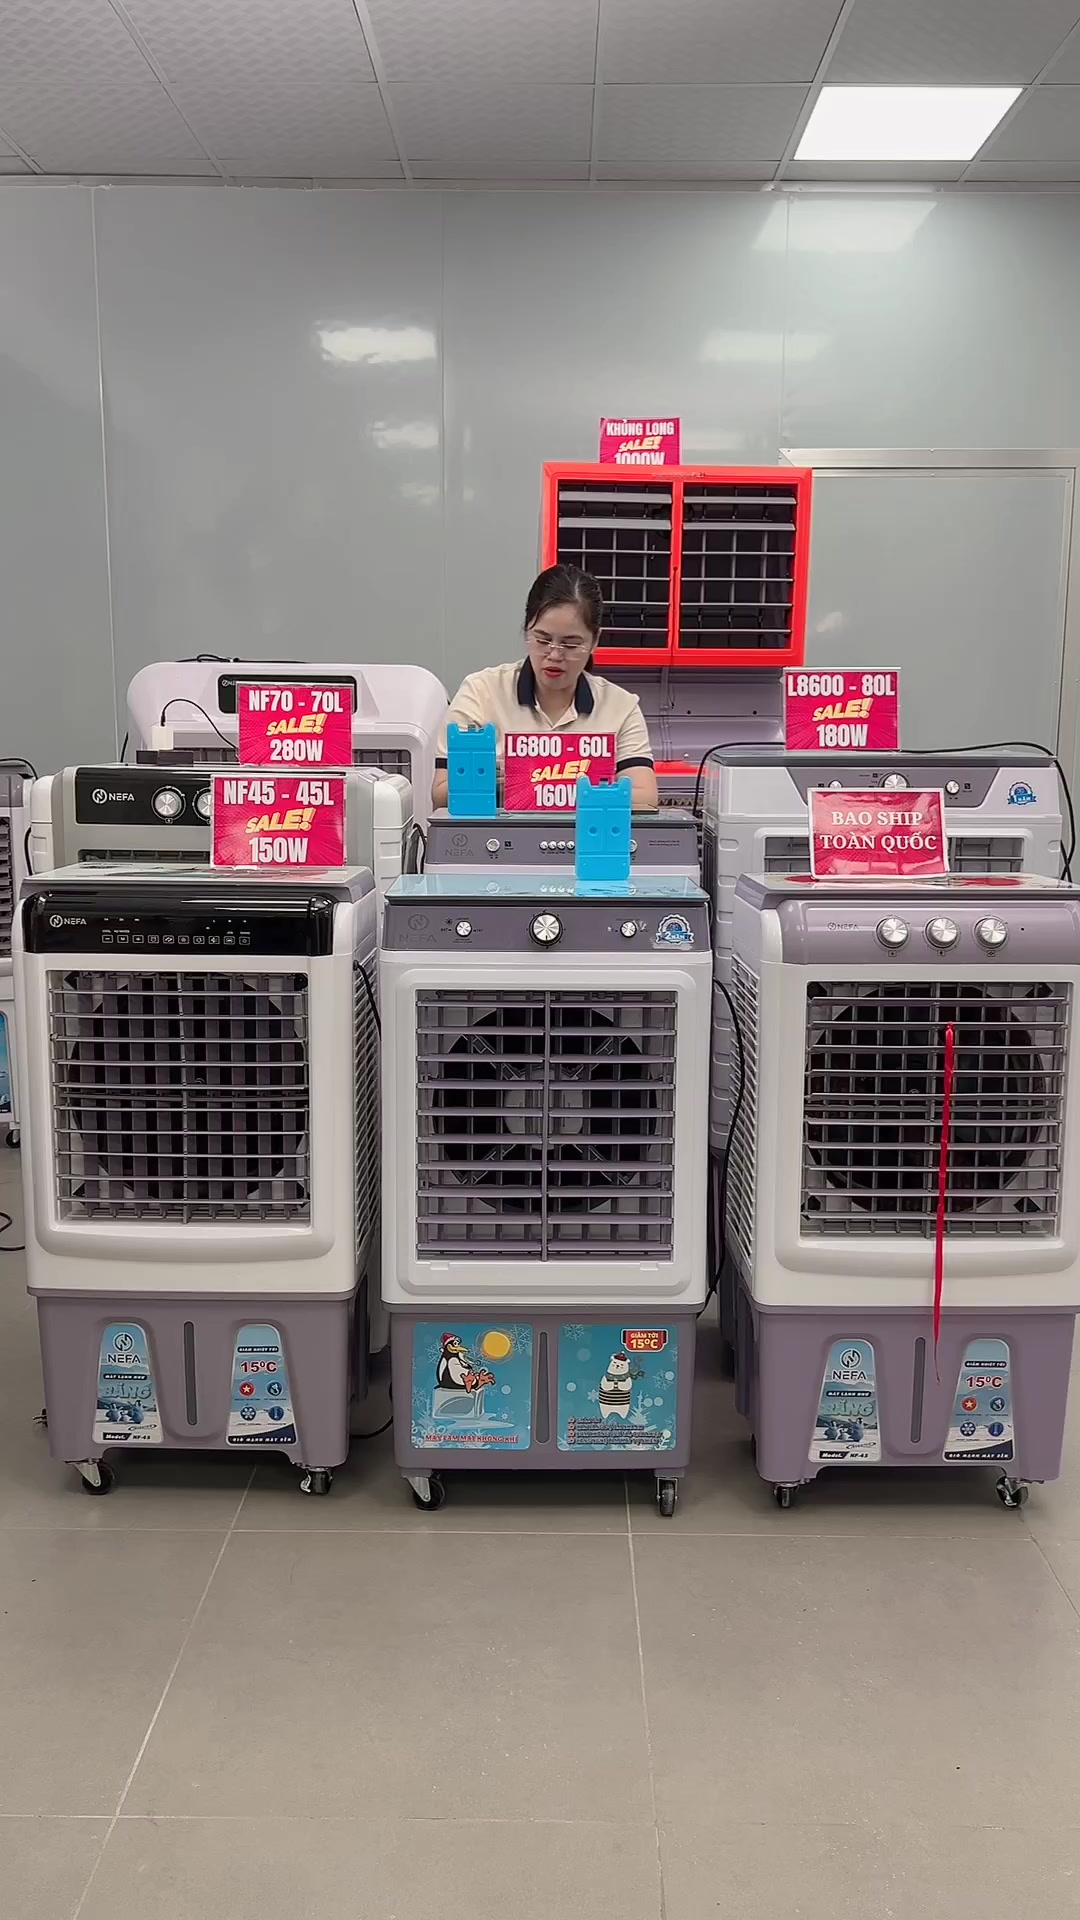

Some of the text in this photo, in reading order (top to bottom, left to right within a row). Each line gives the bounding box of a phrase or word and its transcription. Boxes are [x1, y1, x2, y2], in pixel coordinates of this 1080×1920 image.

[606, 419, 674, 436] KHỦNG LONG
[618, 435, 663, 452] SALE!
[614, 452, 665, 465] 1000W
[787, 674, 844, 696] L8600
[861, 674, 895, 696] 80L
[248, 690, 293, 711] NF70
[311, 691, 343, 712] 70L
[812, 697, 873, 721] SALE!
[266, 713, 328, 736] SALE!
[816, 724, 868, 747] 180W
[270, 739, 323, 762] 280W
[507, 736, 562, 757] L6800
[579, 736, 611, 757] 60L
[530, 759, 591, 782] SALE!
[108, 793, 135, 801] NEFA
[223, 780, 275, 805] NF45
[296, 781, 334, 806] 45L
[245, 807, 316, 834] SALE!
[831, 811, 922, 826] BAO SHIP
[249, 837, 308, 863] 150W
[820, 832, 937, 854] TOÀN QUỐC
[107, 1353, 141, 1364] NEFA
[832, 1370, 867, 1380] NEFA
[103, 1382, 151, 1399] BĂNG
[824, 1400, 874, 1417] BĂNG
